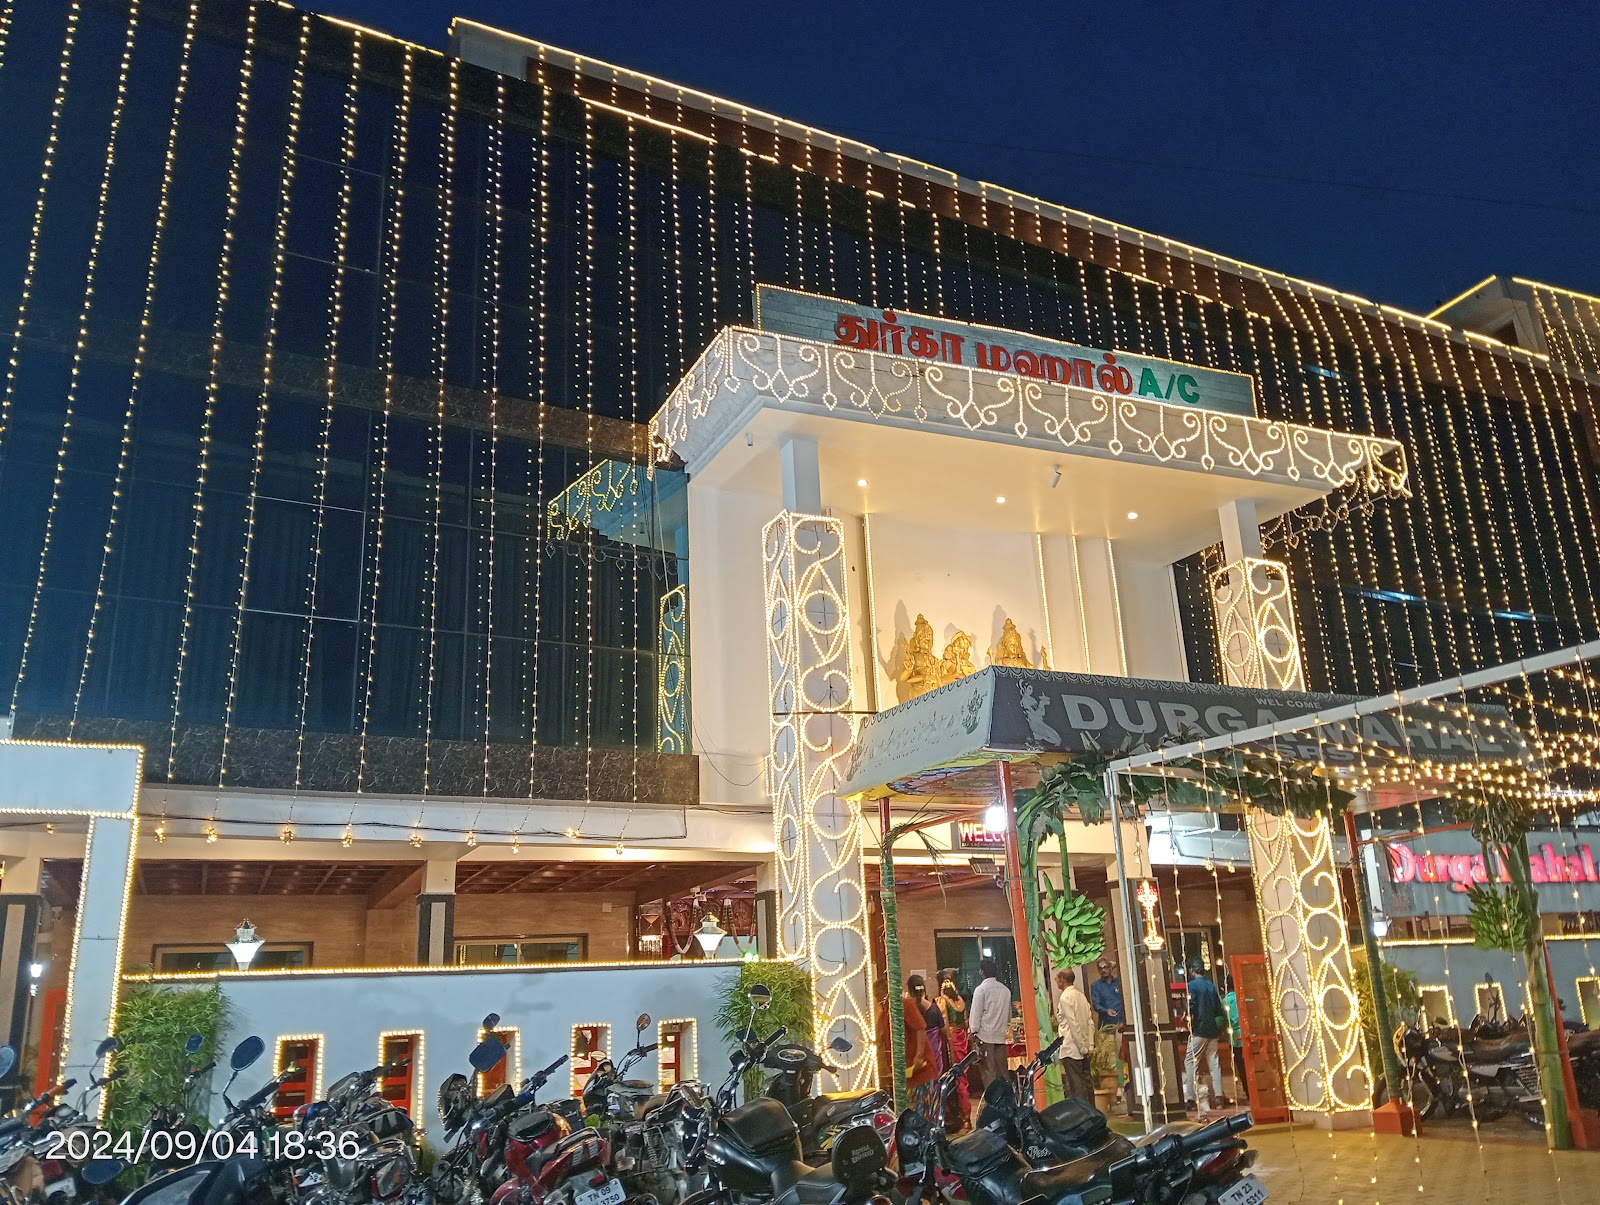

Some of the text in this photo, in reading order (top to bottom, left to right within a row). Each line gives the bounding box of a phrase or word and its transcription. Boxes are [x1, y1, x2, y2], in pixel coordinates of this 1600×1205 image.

[833, 308, 1200, 404] துர்கா மஹால் A/C
[1287, 699, 1322, 709] COME
[1387, 843, 1488, 893] Durga
[588, 1186, 611, 1201] TN 09
[1231, 1182, 1253, 1202] TN 23
